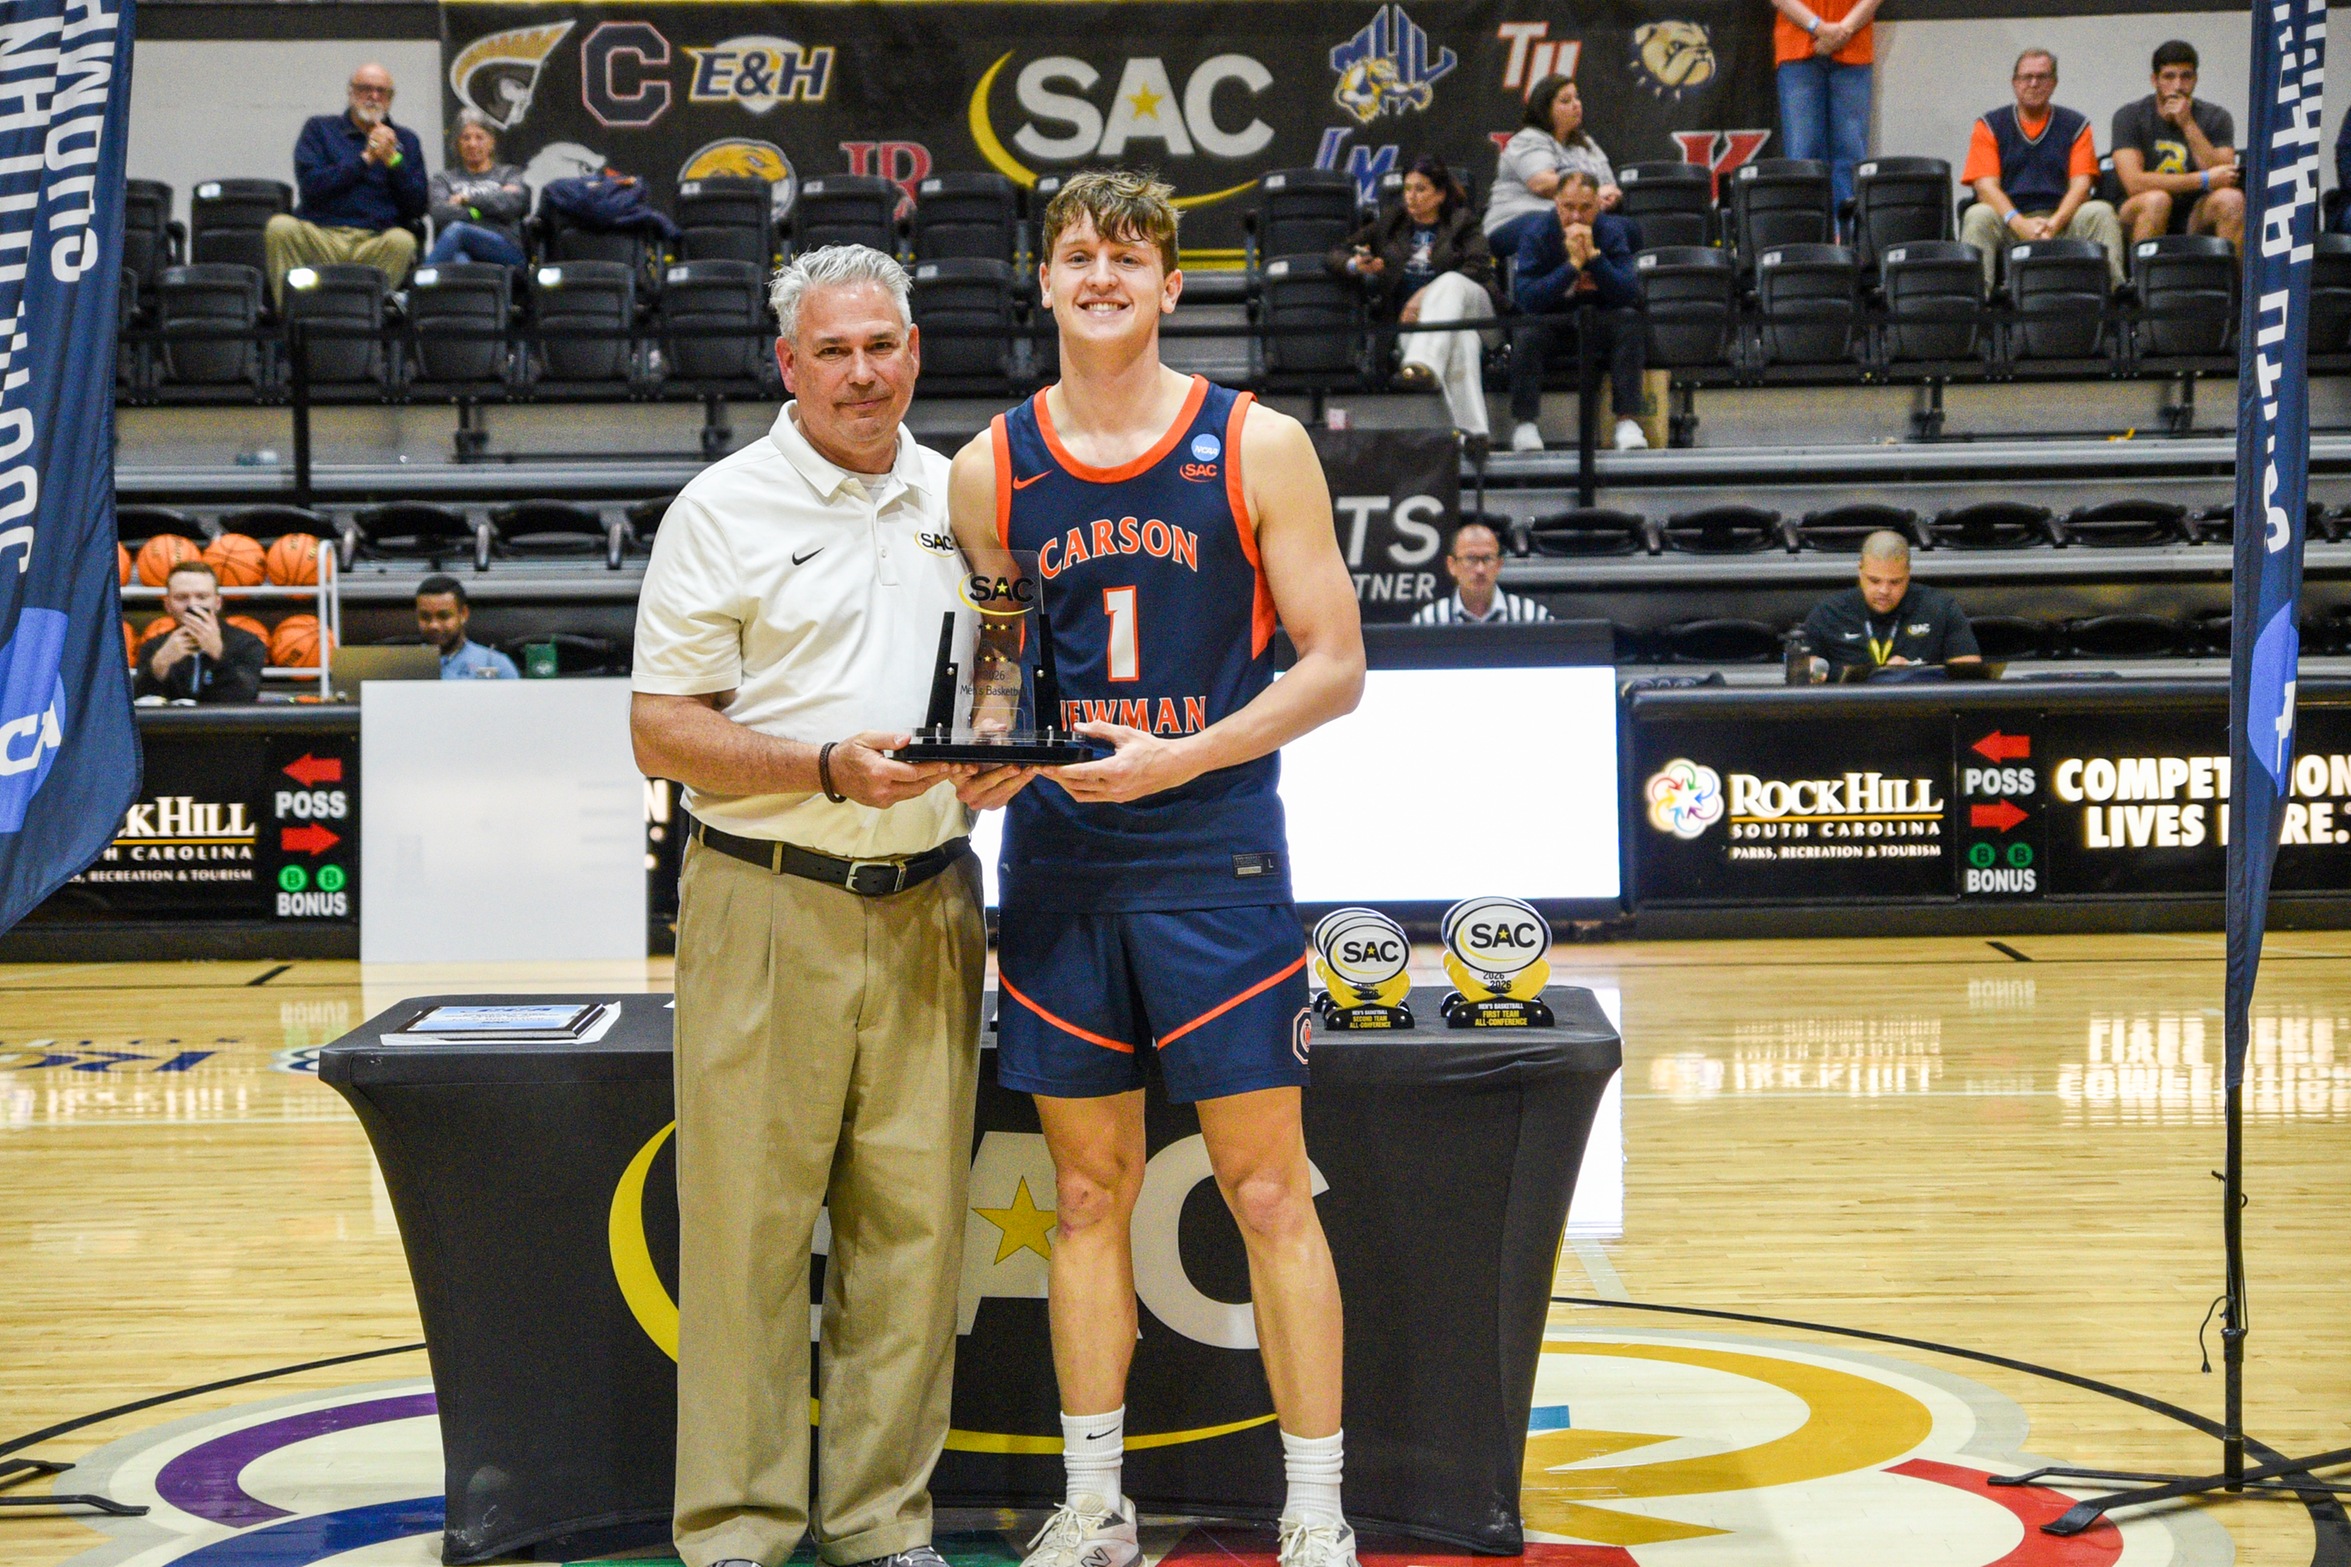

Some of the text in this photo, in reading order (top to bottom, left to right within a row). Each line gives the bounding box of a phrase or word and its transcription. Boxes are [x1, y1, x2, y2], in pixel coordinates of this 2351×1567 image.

[686, 45, 836, 104] E&H
[1013, 54, 1275, 161] SAC
[1185, 463, 1218, 477] SAC
[921, 533, 953, 551] SAC
[1038, 516, 1198, 579] CARSON
[969, 576, 1035, 602] SAC
[1103, 585, 1140, 682] 1
[1965, 768, 2036, 796] POSS
[2055, 754, 2351, 802] COMPETON
[120, 796, 256, 838] KHILL
[275, 791, 347, 819] POSS
[1732, 822, 1941, 839] SOUTH CAROLINA
[2087, 804, 2206, 848] LIVES
[131, 846, 253, 862] CAROLINA
[1733, 844, 1942, 861] PARKS, RECREATION & TOURISM
[91, 869, 173, 883] RECREATION
[177, 870, 188, 882] &
[191, 869, 252, 882] TOURISM
[1967, 869, 2037, 893] BONUS
[276, 892, 347, 916] BONUS
[1470, 923, 1536, 948] SAC
[1343, 940, 1399, 963] SAC
[1490, 980, 1512, 989] 2026
[1475, 1017, 1528, 1026] ALL-CONFERENCE
[1483, 1010, 1520, 1018] FIRST TEAM
